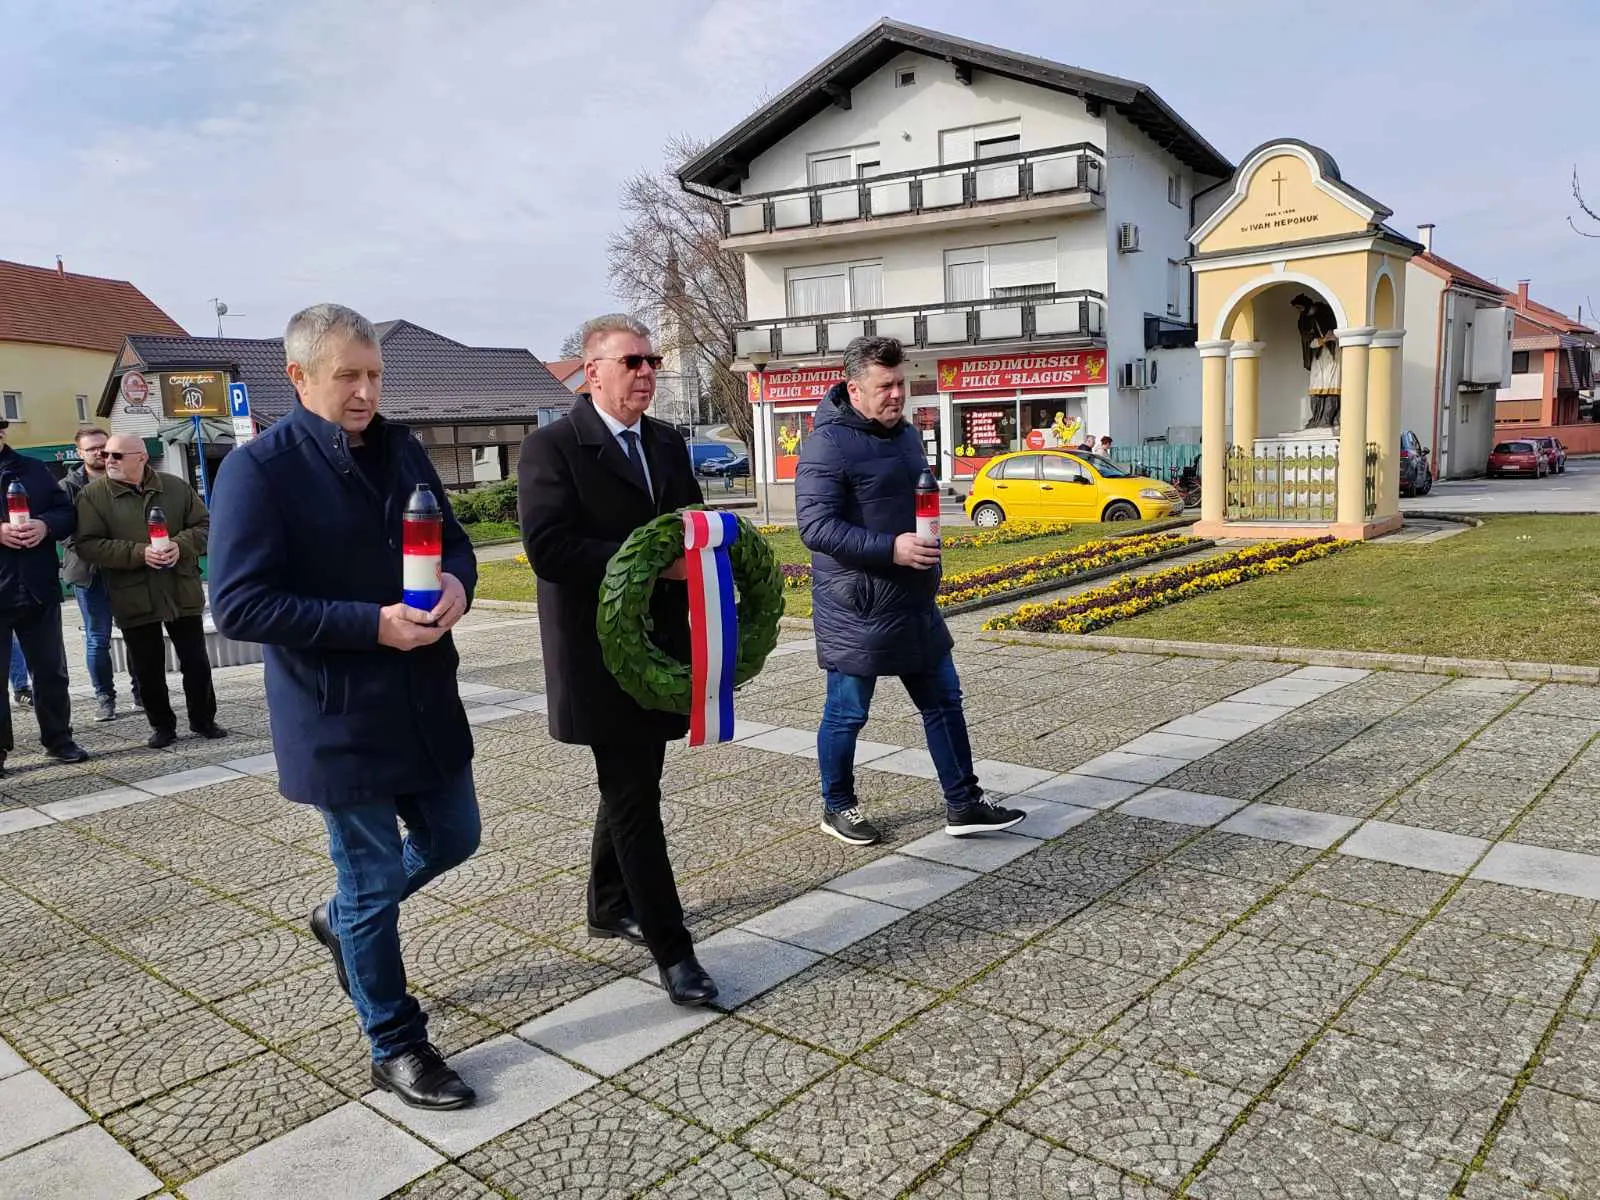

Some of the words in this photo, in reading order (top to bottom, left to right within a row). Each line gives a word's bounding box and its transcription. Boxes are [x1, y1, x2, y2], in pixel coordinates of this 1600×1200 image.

[1249, 222, 1271, 231] IVAN
[1274, 214, 1319, 228] NEPOMUK
[961, 371, 1001, 388] PILIĆI
[232, 388, 243, 412] P
